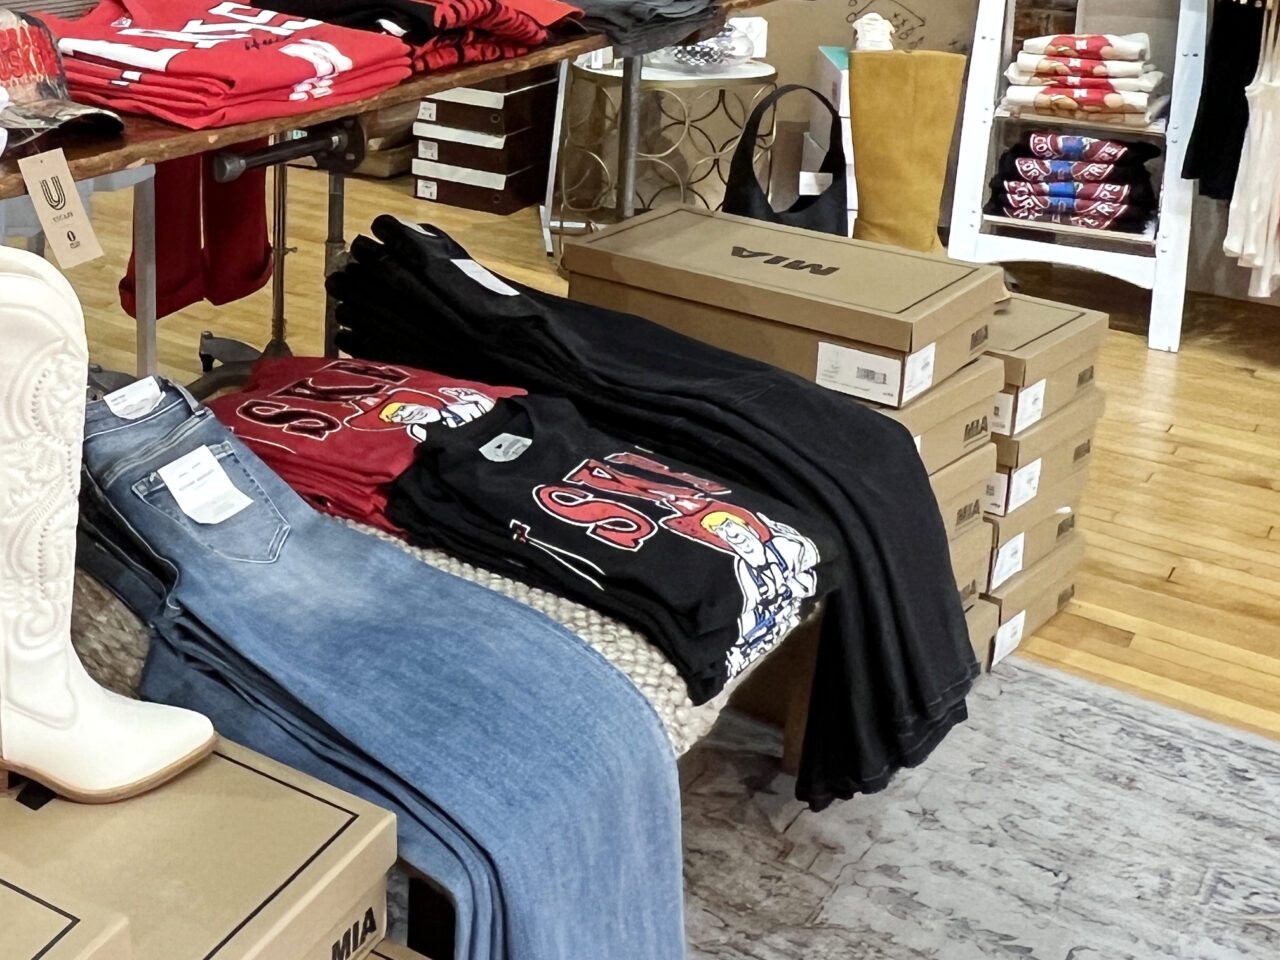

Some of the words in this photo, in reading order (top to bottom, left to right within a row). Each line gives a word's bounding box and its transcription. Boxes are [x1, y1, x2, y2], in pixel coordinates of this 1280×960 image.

[730, 245, 840, 276] MIA
[963, 414, 989, 442] MIA
[330, 905, 377, 960] MIA
